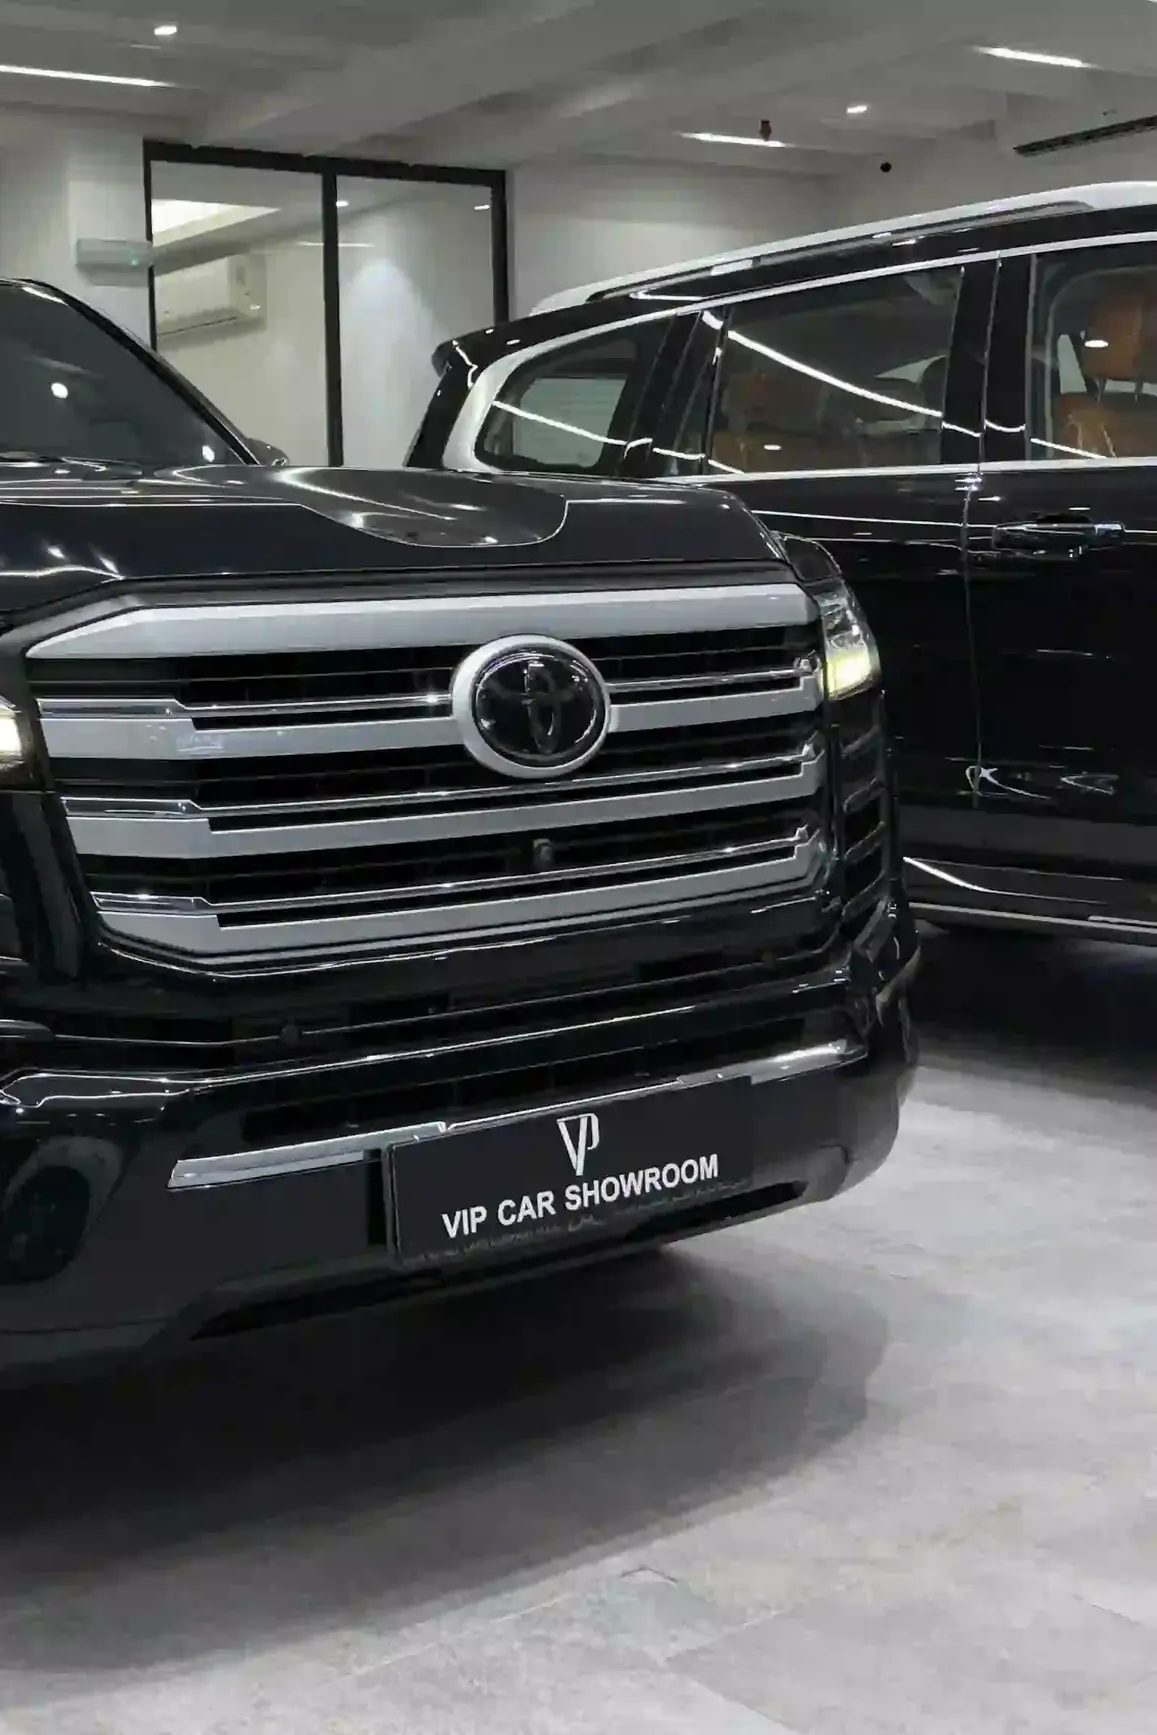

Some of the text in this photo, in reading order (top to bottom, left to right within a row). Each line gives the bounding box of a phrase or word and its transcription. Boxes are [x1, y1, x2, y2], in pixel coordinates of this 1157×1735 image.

[441, 1206, 488, 1239] VIP
[497, 1191, 557, 1226] CAR
[564, 1154, 719, 1211] SHOWROOM
